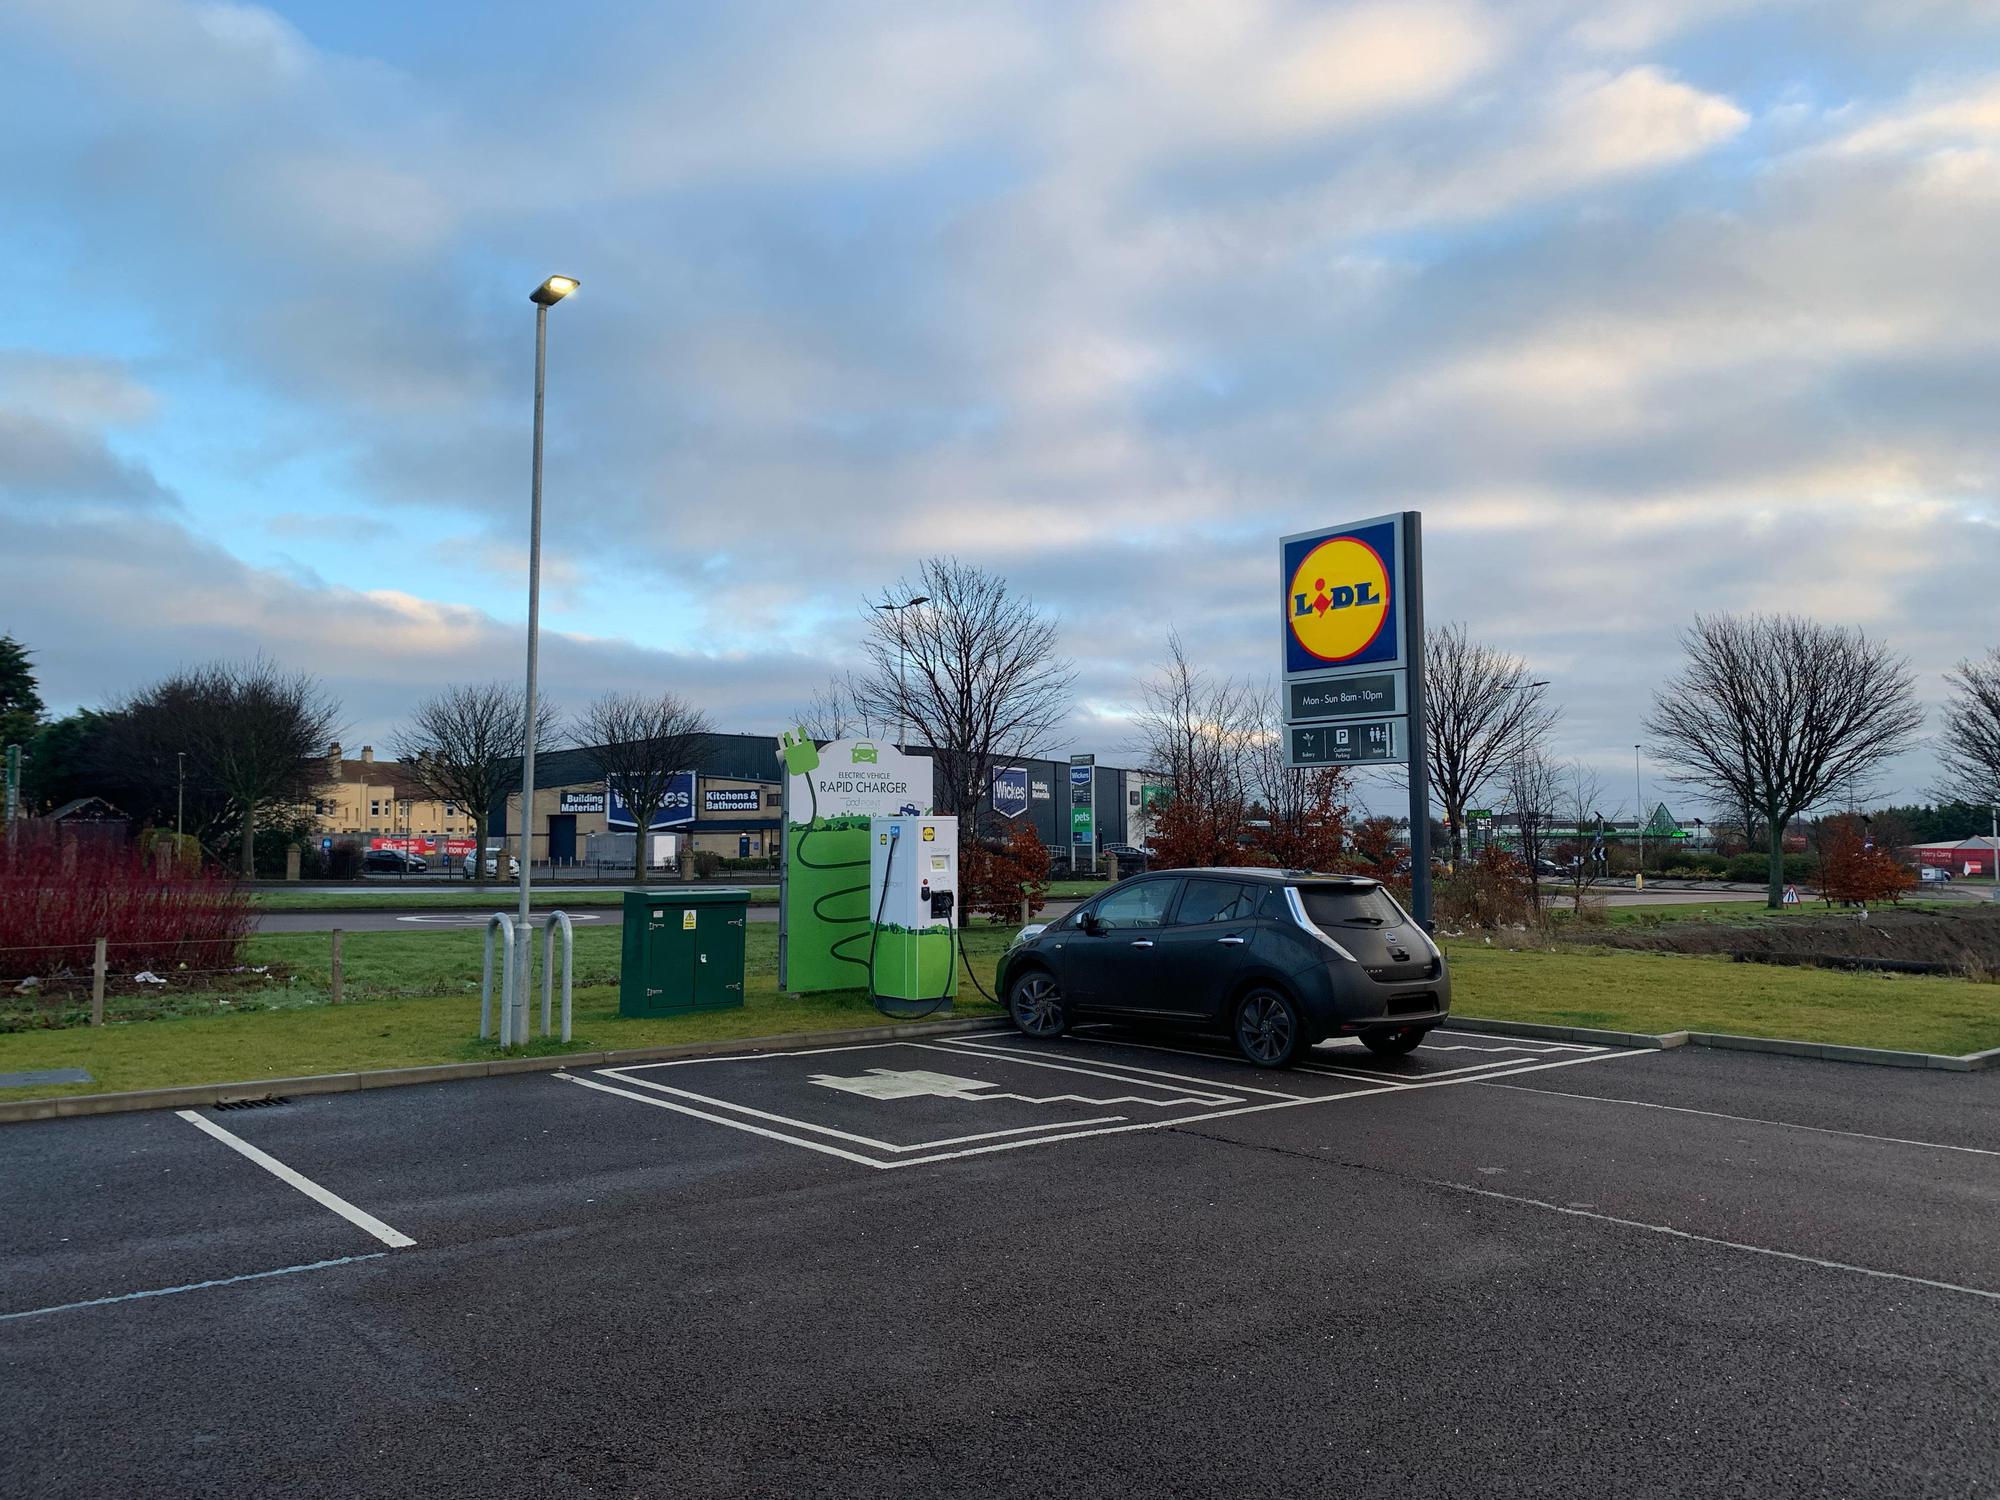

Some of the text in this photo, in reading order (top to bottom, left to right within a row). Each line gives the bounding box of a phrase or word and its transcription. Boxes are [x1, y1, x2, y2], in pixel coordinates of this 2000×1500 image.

[1302, 696, 1320, 706] Mon
[1324, 694, 1339, 704] Sun
[1340, 692, 1357, 702] 8am
[1362, 690, 1383, 702] 10pm
[838, 771, 891, 780] ELECTRIC VEHICLE
[1072, 771, 1089, 779] Wickes
[820, 781, 907, 794] RAPID CHARGER
[996, 780, 1026, 800] Wickes
[1031, 781, 1048, 791] Building
[567, 794, 604, 805] Building
[706, 791, 758, 801] Kitchens &
[561, 803, 604, 812] Materials
[706, 800, 758, 811] Bathrooms
[1074, 811, 1090, 824] pets
